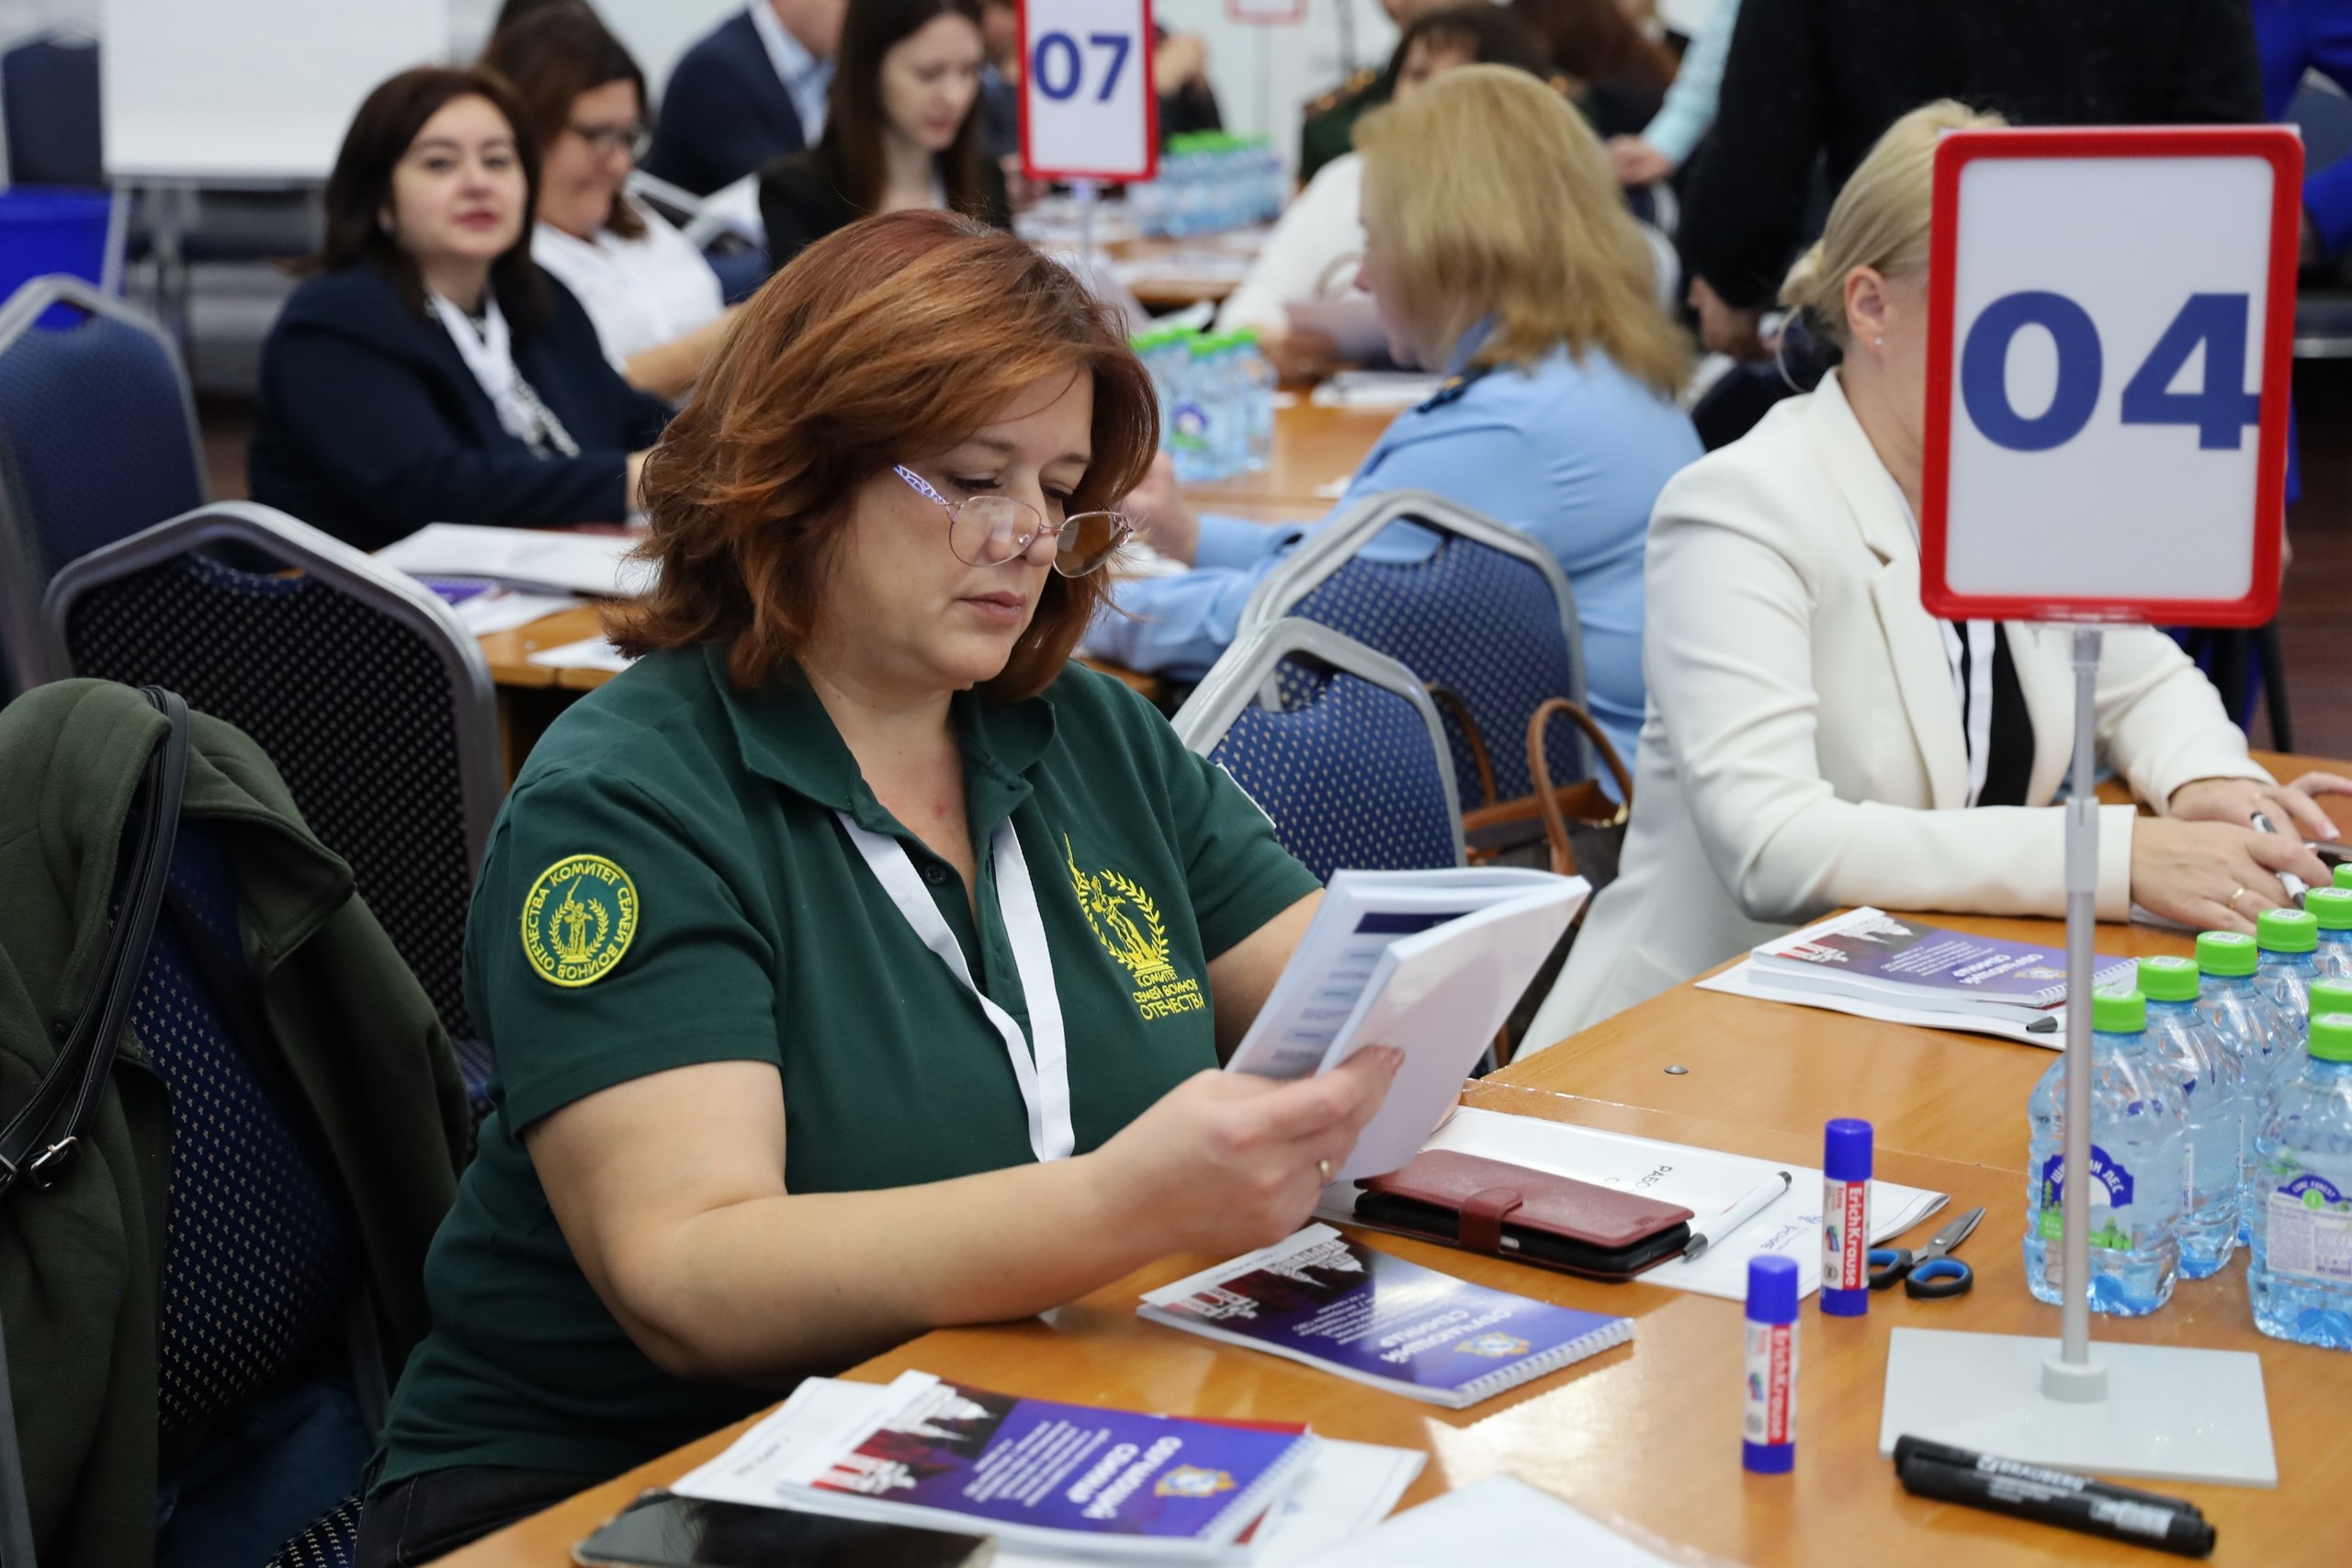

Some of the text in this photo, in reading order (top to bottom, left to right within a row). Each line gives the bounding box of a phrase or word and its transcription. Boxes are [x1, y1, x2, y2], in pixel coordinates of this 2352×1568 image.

[1031, 32, 1130, 101] 07
[1961, 290, 2261, 452] 04
[549, 862, 620, 886] КОМИТЕТ
[528, 888, 555, 971] ОТЕЧЕСТВА
[558, 942, 618, 979] ВОИНОВ
[1162, 978, 1198, 997] ВОИНОВ
[1140, 992, 1205, 1021] ОТЕЧЕСТВА
[2102, 1169, 2124, 1194] ЛЕС
[1845, 1187, 1863, 1286] ErichKrause
